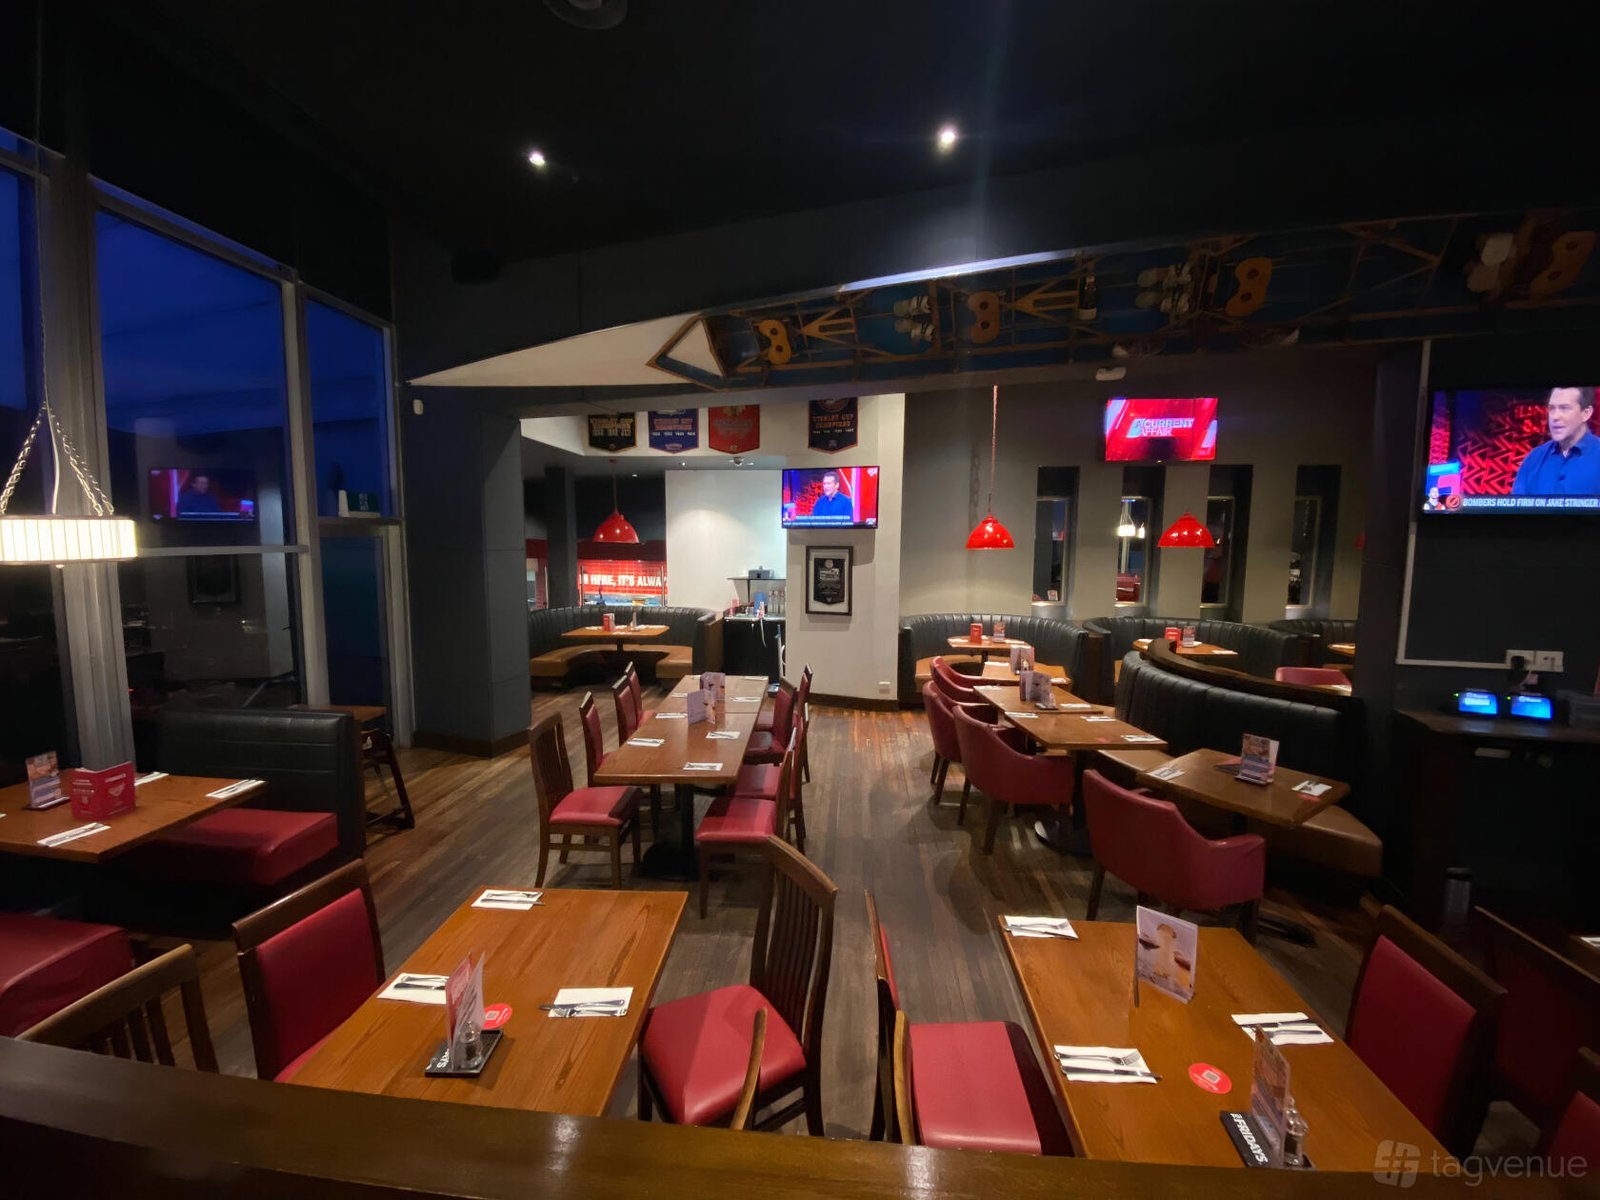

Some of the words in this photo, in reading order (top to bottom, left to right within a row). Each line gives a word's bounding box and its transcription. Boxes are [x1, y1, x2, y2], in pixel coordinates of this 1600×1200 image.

[1141, 428, 1173, 437] AFFAIR
[1463, 498, 1496, 507] BOMBERS
[1497, 498, 1516, 507] HOLD
[1517, 498, 1534, 507] FIRM
[1535, 499, 1546, 507] ON
[1546, 499, 1564, 507] JAKE
[1565, 499, 1599, 508] STRINGER
[636, 575, 668, 587] ALWA
